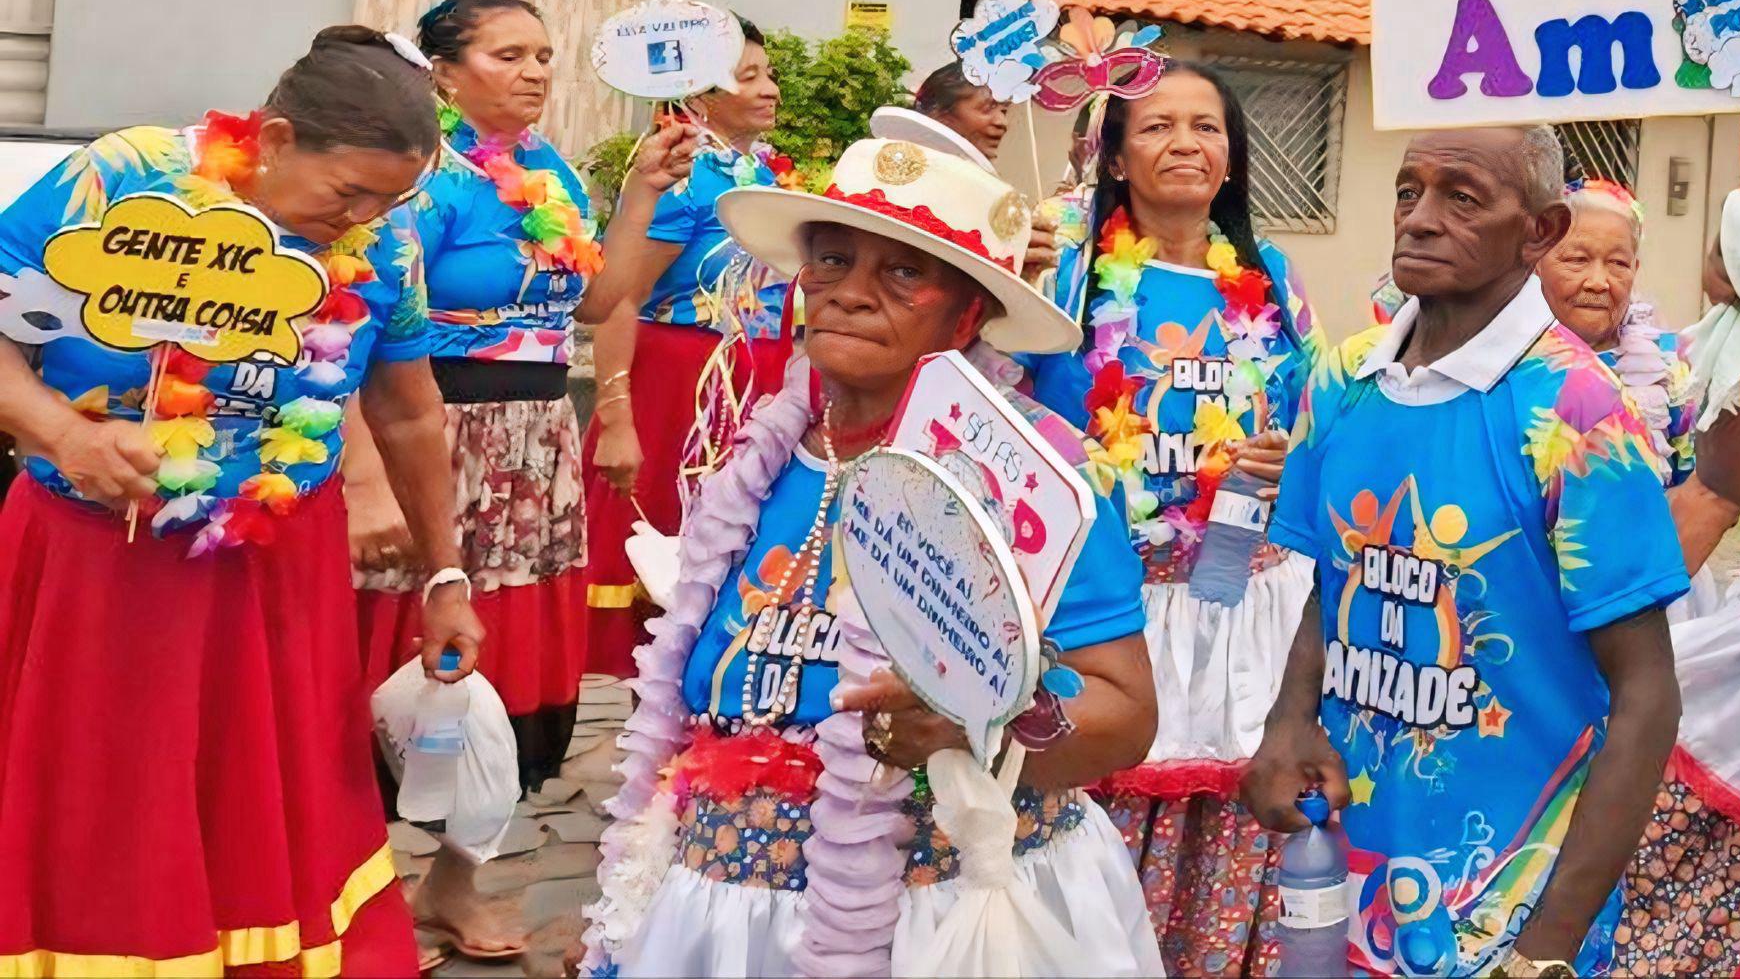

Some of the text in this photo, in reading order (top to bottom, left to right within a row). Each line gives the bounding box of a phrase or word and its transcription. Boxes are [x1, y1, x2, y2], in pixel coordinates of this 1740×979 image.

[103, 226, 264, 274] GENTE XIC
[176, 273, 190, 288] E
[98, 284, 190, 323] OUTRA
[195, 300, 278, 336] COISA
[230, 363, 276, 400] DA
[1364, 547, 1437, 604] BLOCO
[1381, 600, 1404, 649] DA
[1322, 640, 1477, 726] AMIZADE
